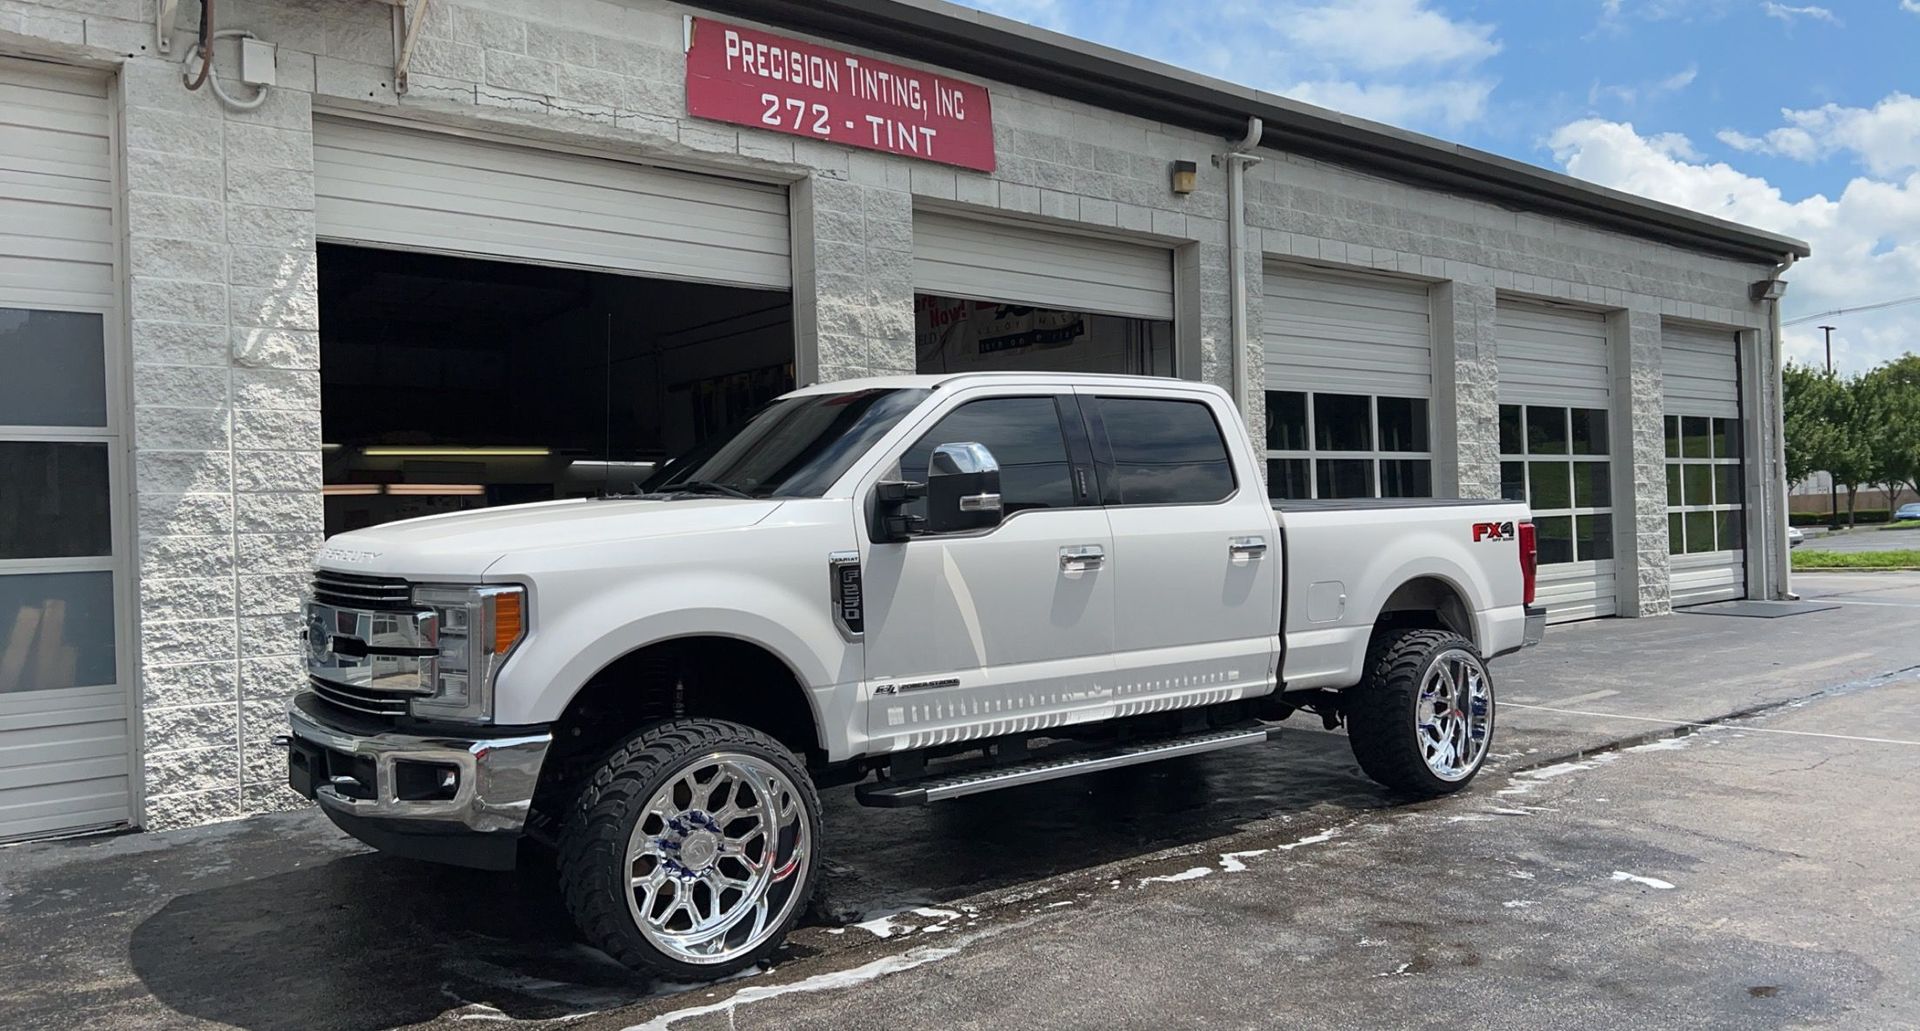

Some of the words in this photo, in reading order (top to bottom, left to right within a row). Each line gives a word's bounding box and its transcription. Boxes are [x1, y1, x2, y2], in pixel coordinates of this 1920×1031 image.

[725, 30, 839, 93] PRECISION
[845, 57, 928, 121] TINTING,
[934, 79, 965, 120] INC
[761, 93, 831, 135] 272
[865, 115, 936, 156] TINT
[1472, 522, 1515, 542] FX4
